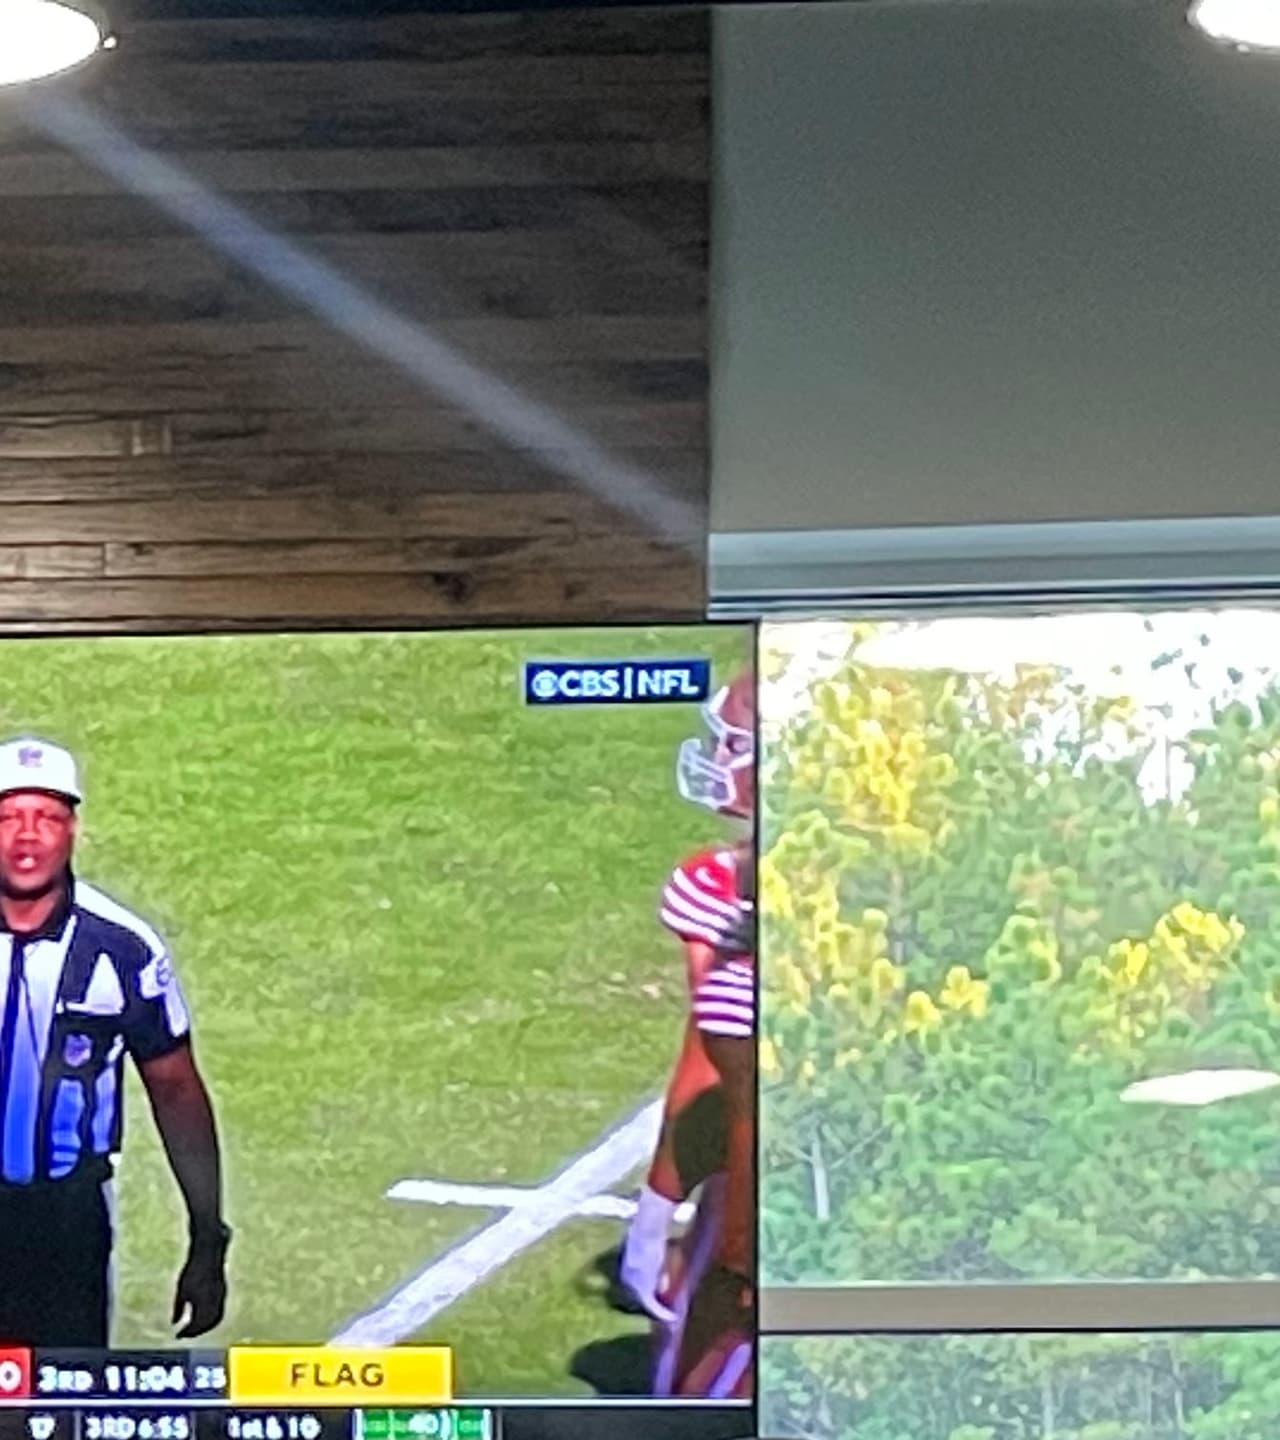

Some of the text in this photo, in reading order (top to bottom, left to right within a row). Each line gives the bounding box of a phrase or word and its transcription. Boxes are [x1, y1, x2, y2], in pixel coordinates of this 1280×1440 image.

[559, 669, 699, 697] CBS NFL
[38, 1365, 93, 1392] 3RD
[104, 1365, 186, 1392] 11:04
[289, 1362, 385, 1388] FLAG
